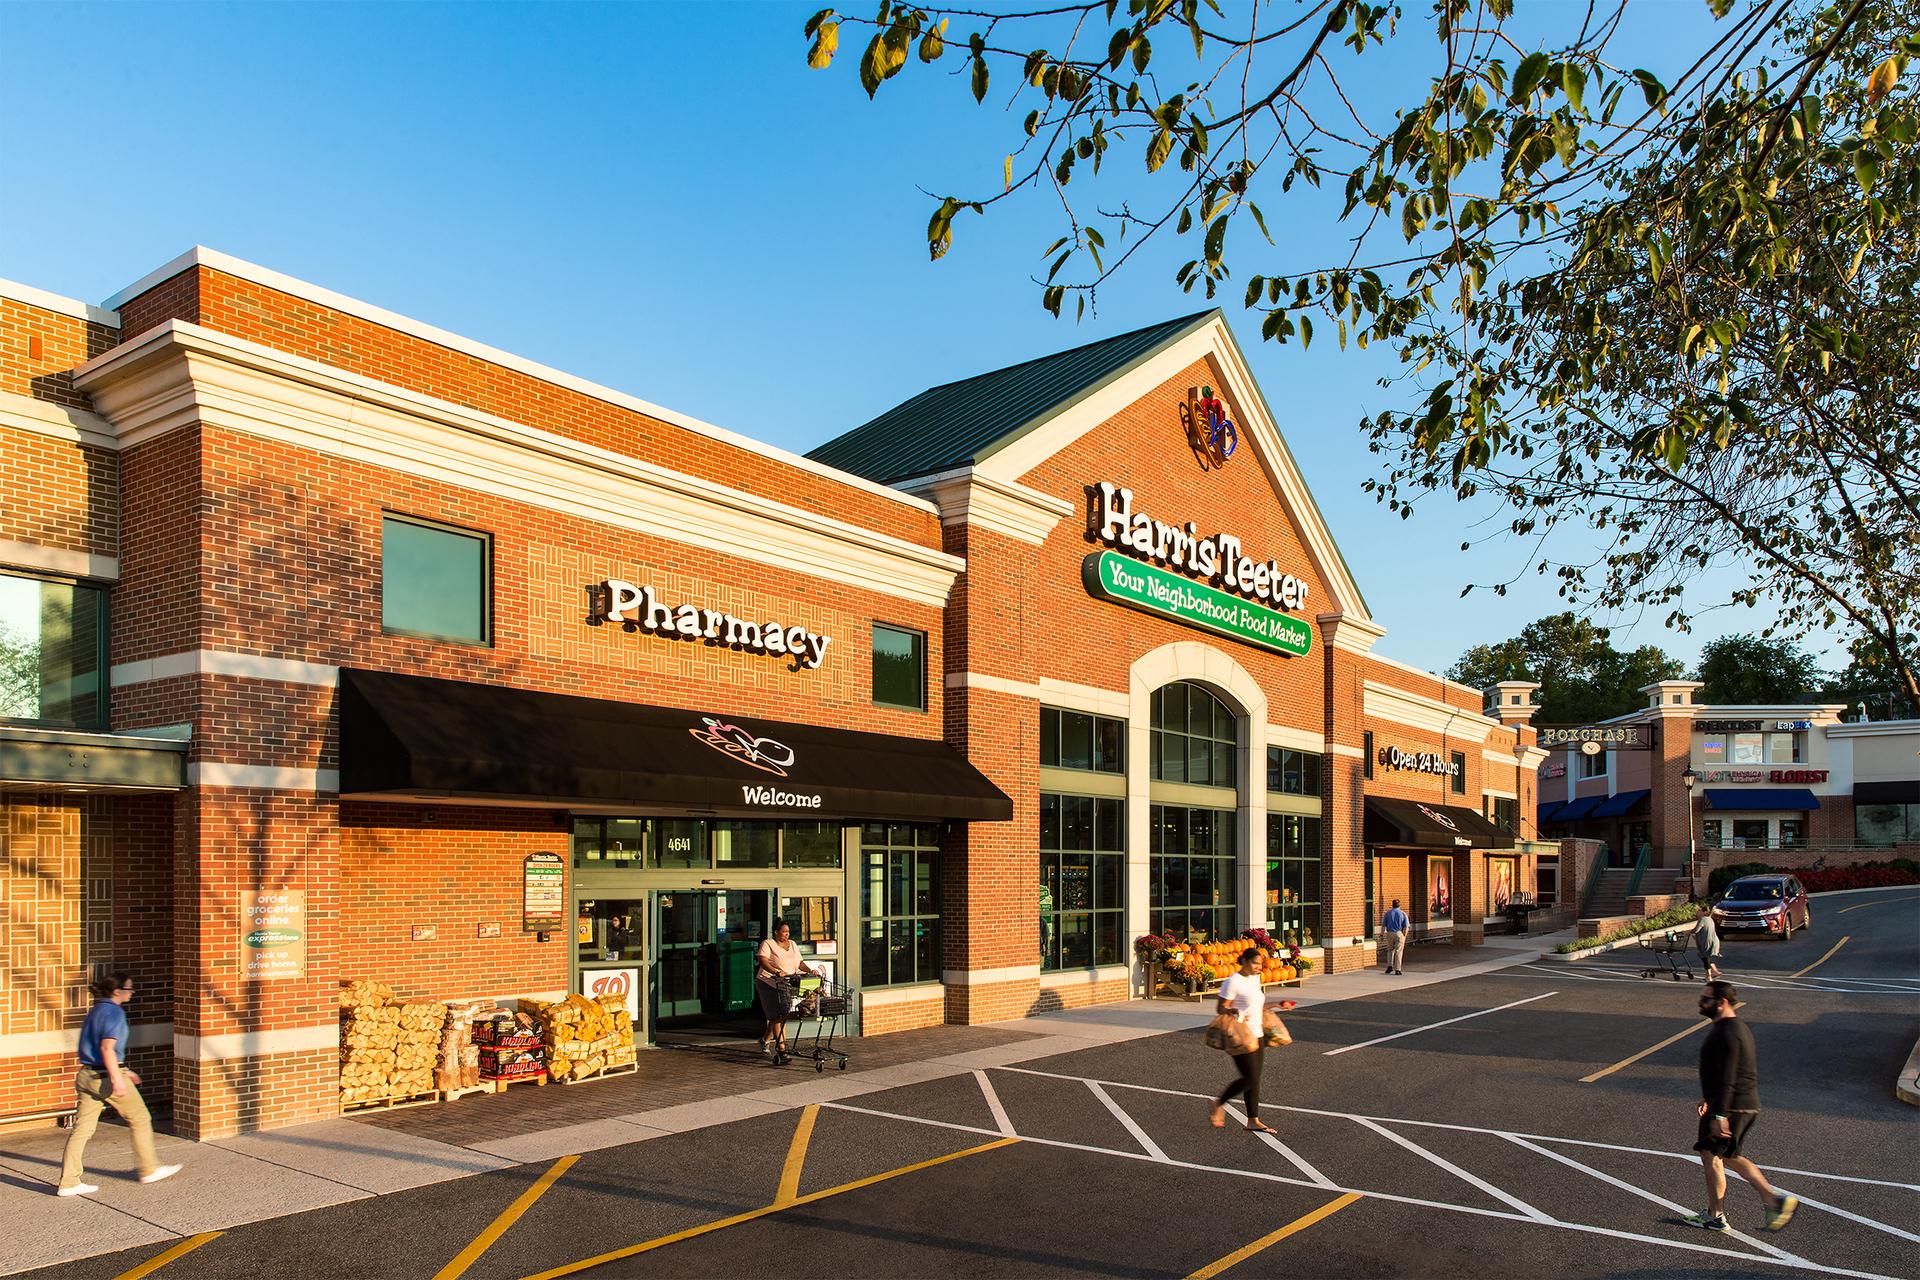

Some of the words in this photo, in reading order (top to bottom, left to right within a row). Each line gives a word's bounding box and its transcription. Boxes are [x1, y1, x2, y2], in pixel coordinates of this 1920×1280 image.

[1100, 482, 1216, 577] Harris
[1219, 533, 1308, 610] Teeter
[1109, 560, 1145, 592] Your
[1147, 576, 1238, 626] Neighborhood
[1240, 609, 1267, 636] Food
[1269, 619, 1306, 648] Market
[607, 579, 832, 669] Pharmacy
[1695, 720, 1764, 732] DENTIST
[1543, 728, 1637, 744] FOXCHASE
[1391, 746, 1417, 771] Open
[1419, 752, 1432, 772] 24
[1433, 754, 1459, 775] Hours
[1770, 770, 1829, 784] FLORIST
[742, 786, 821, 808] Welcome
[668, 838, 690, 851] 4641
[257, 894, 288, 904] order
[246, 904, 299, 917] groceries
[255, 915, 292, 925] online.
[256, 951, 274, 961] pick
[247, 961, 270, 969] drive
[501, 1036, 541, 1047] KINDLING
[504, 1060, 542, 1075] KINDLING
